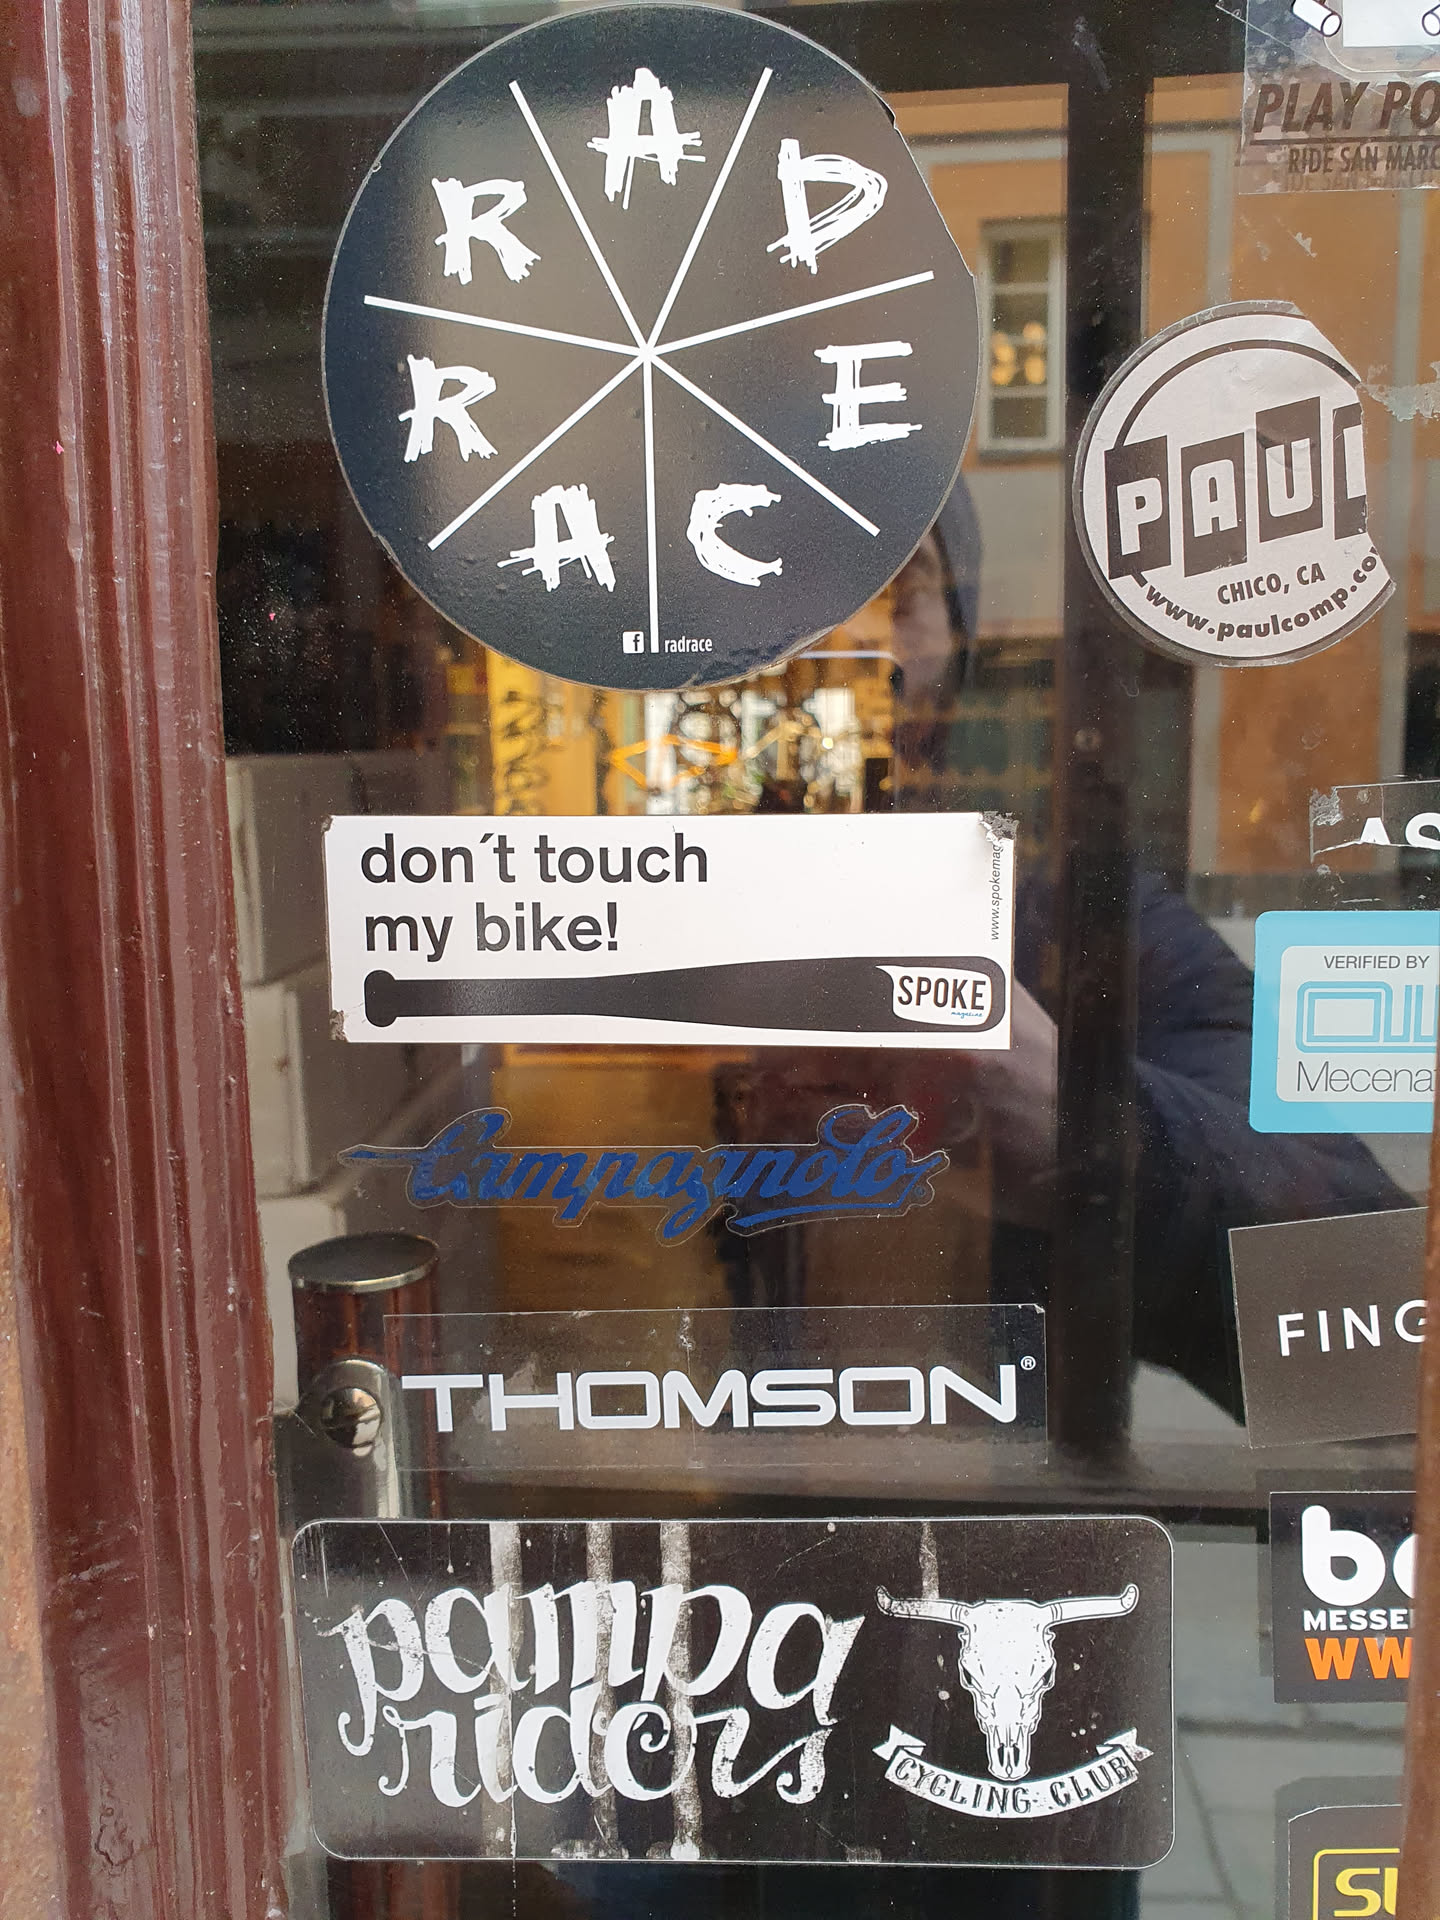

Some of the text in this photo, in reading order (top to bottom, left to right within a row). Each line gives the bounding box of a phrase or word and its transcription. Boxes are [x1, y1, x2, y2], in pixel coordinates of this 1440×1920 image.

[1252, 81, 1371, 133] PLAY
[1288, 147, 1334, 174] RIDE
[1339, 146, 1379, 172] SAN
[1217, 562, 1326, 605] CHICO, CA
[664, 636, 713, 653] radrace
[533, 832, 708, 884] touch
[365, 901, 619, 963] my bike!
[1323, 954, 1431, 969] VERIFIED BY
[897, 974, 987, 1011] SPOKE
[1297, 1060, 1438, 1094] Mecena
[1303, 1608, 1416, 1632] MESSE
[316, 1581, 866, 1756] pampa
[377, 1680, 832, 1807] riders
[895, 1754, 1137, 1815] CYCLING CLUB
